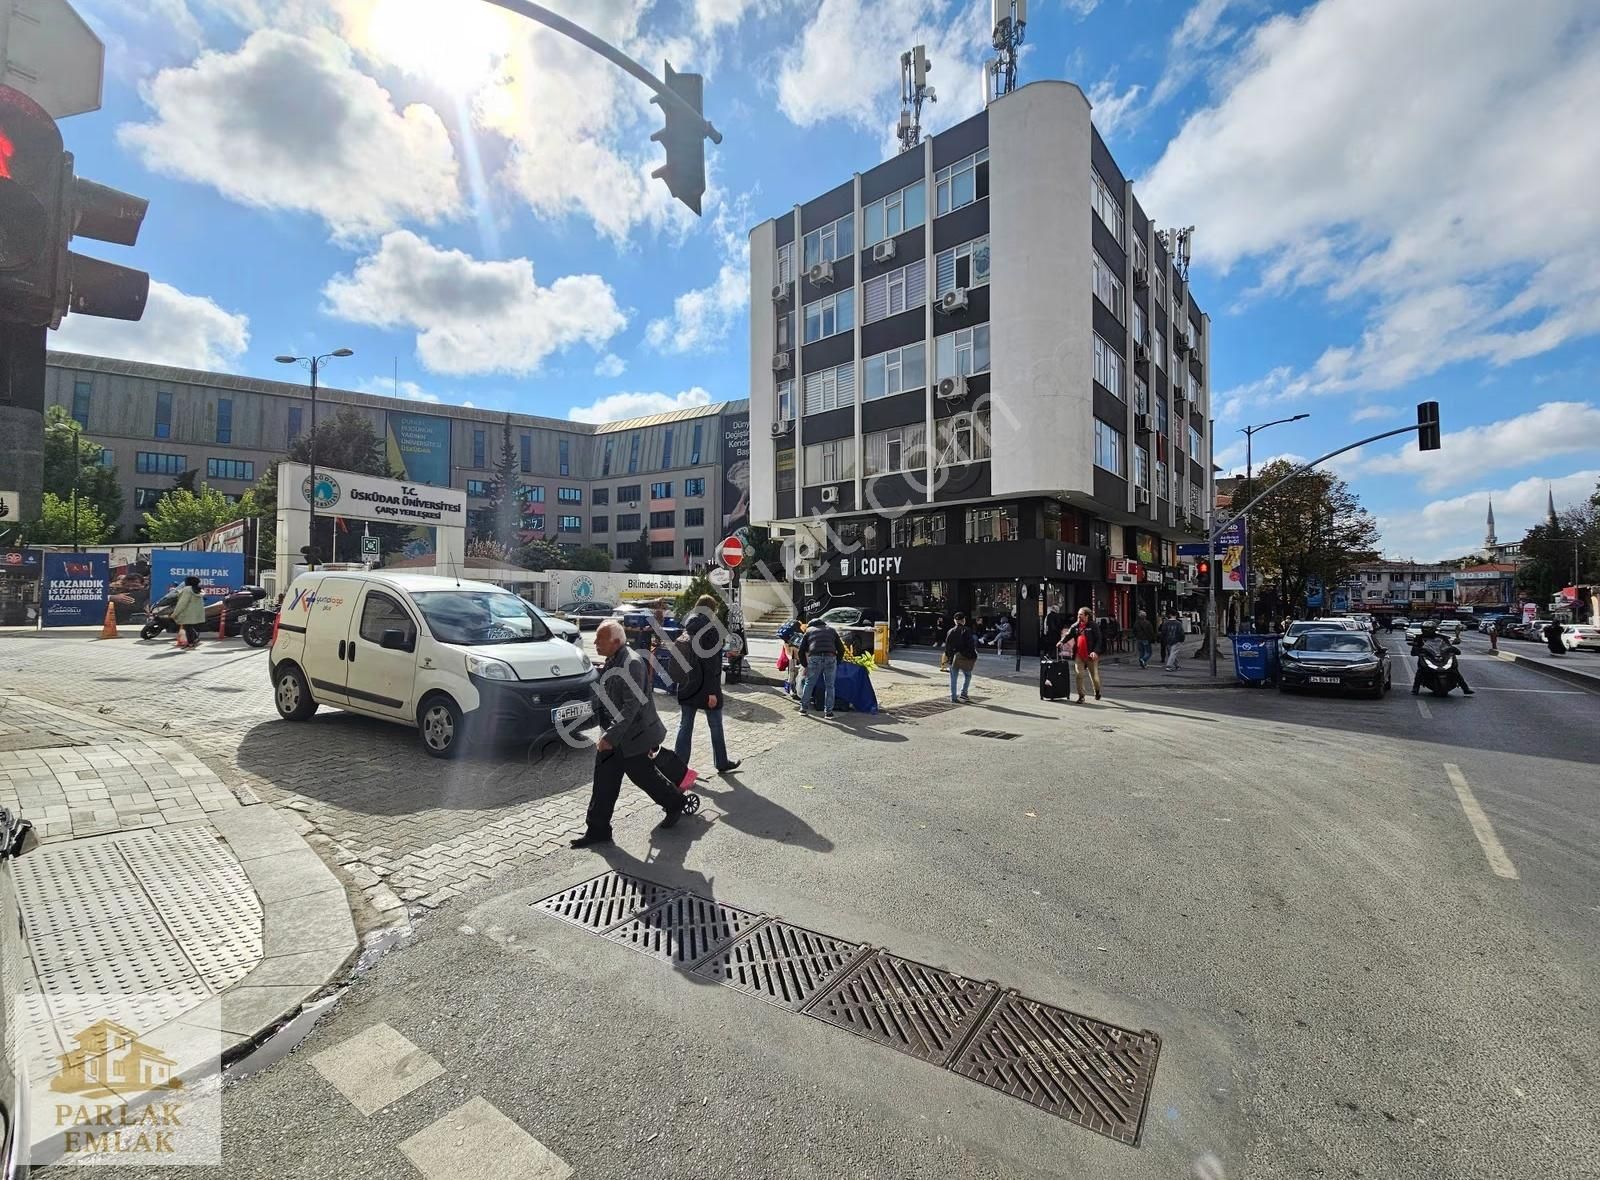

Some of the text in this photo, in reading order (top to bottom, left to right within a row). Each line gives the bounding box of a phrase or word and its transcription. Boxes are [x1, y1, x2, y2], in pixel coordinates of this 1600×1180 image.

[401, 486, 418, 496] T.C.
[350, 489, 461, 513] ÜSKÜDAR ÜNİVERSİTESİ
[375, 506, 441, 520] ÇARŞI YERLEŞKESİ
[861, 556, 902, 575] COFFY
[1067, 552, 1087, 573] COFFY
[211, 569, 229, 577] PAK
[50, 579, 104, 588] KAZANDIK
[628, 579, 659, 589] Bilimden
